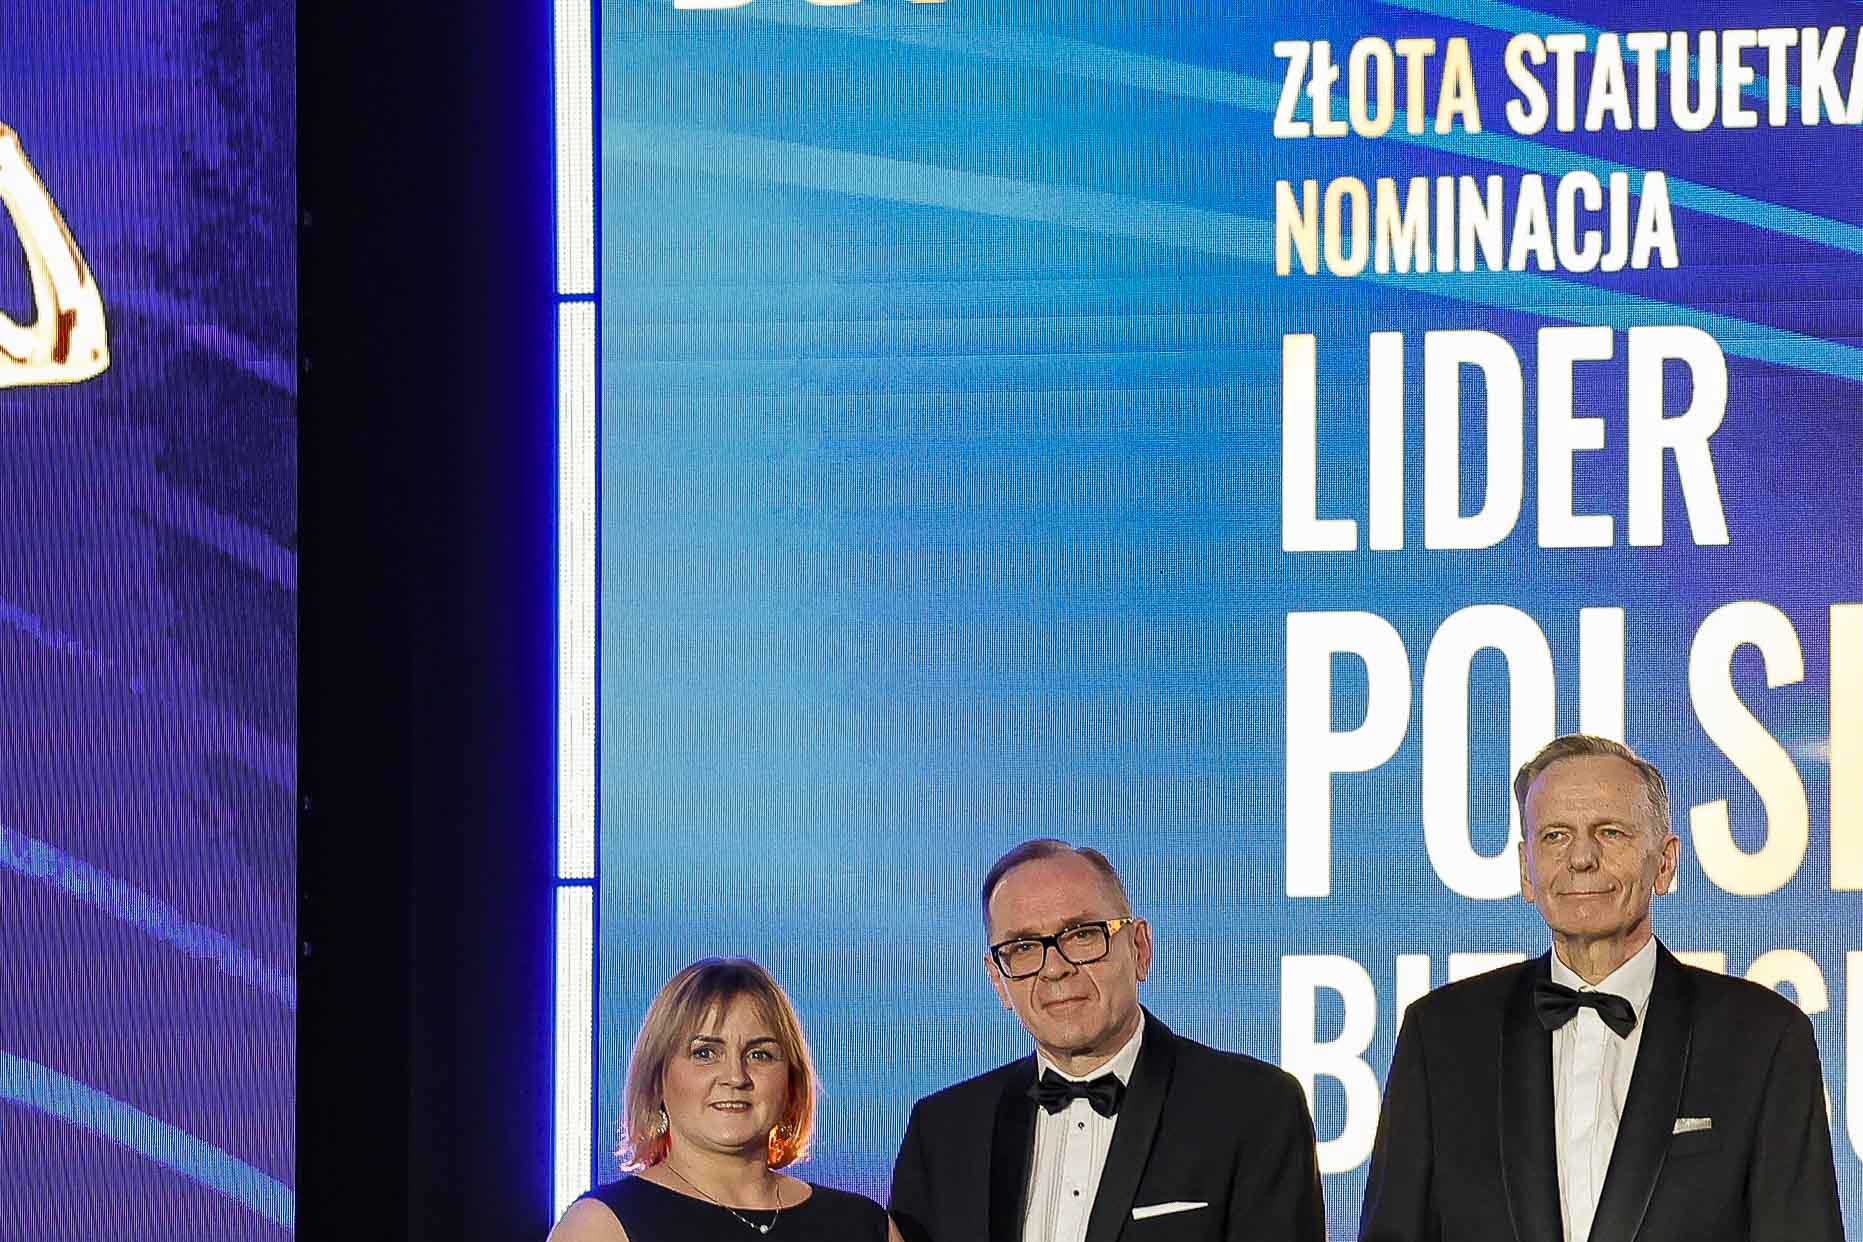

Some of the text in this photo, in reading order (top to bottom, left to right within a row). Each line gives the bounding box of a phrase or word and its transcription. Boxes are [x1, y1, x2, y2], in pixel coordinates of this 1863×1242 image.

[1272, 36, 1482, 138] ZŁOTA
[1274, 170, 1680, 277] NOMINACJA
[1281, 325, 1731, 553] LIDER
